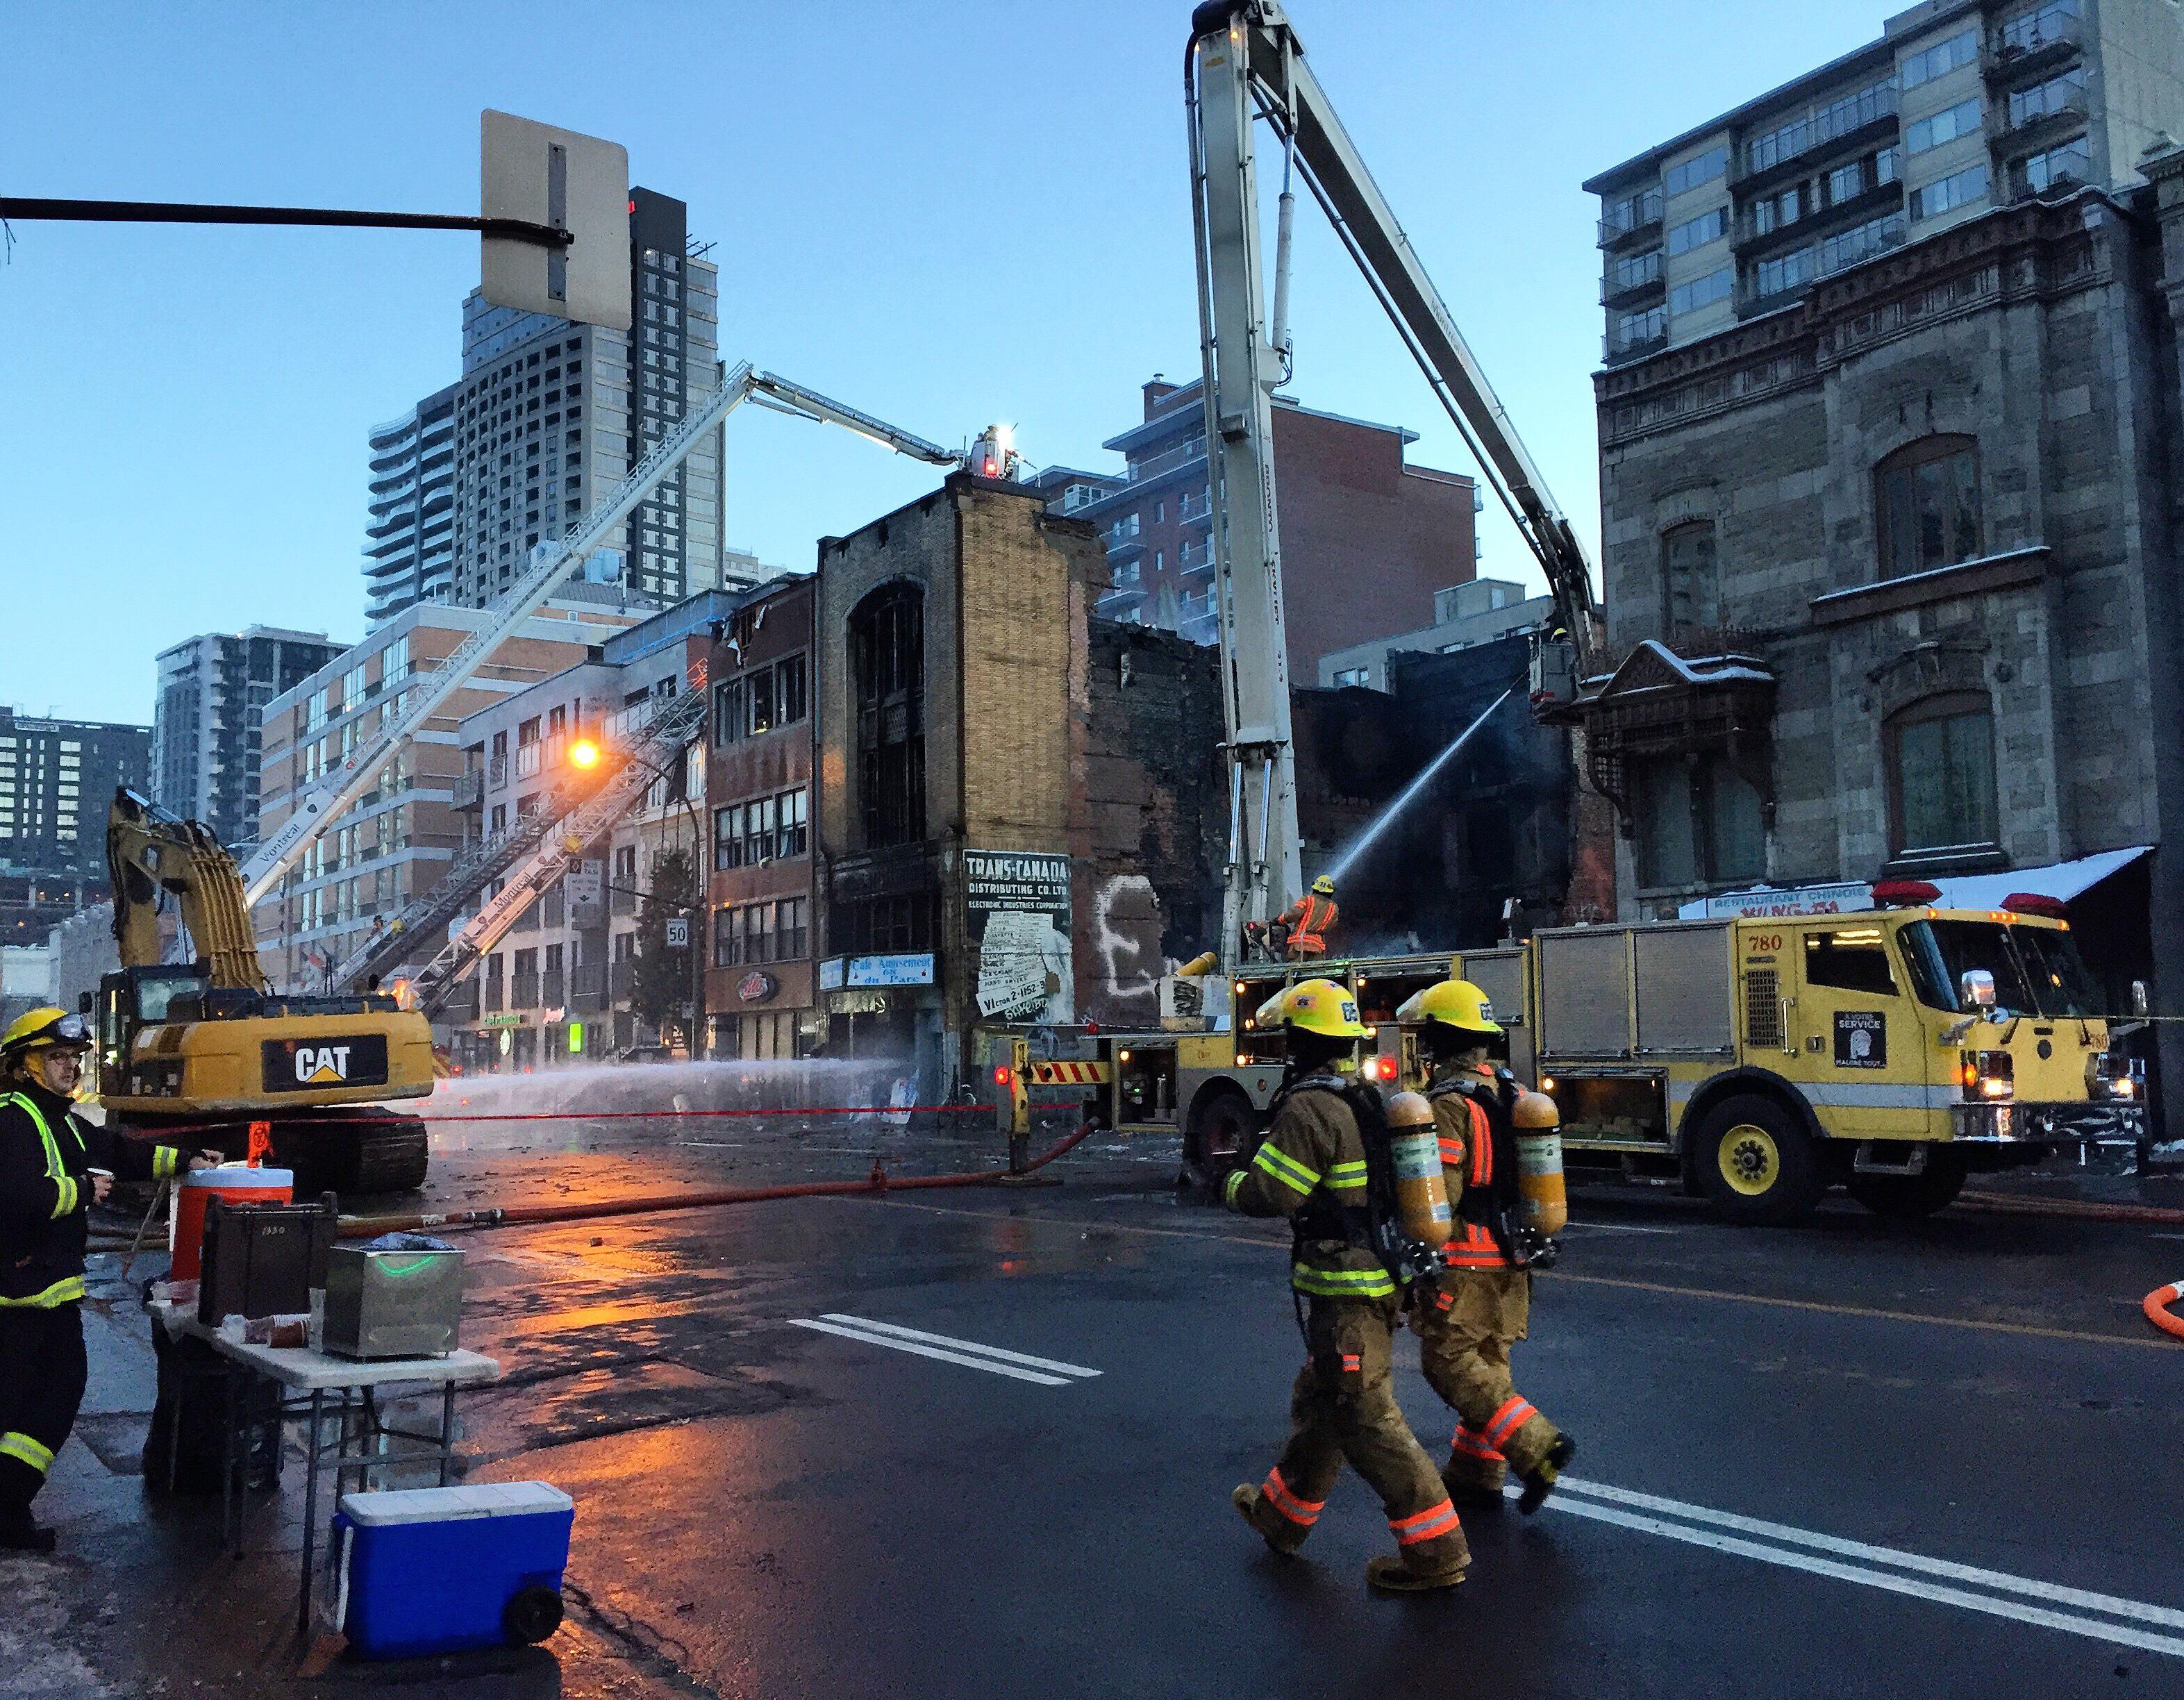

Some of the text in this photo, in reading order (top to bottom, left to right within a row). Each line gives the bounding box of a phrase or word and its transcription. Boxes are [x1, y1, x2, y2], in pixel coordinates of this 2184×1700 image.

[967, 858, 1067, 882] TRANS-CANADA
[969, 883, 1033, 895] DISTRIBUTING
[1715, 887, 1867, 908] RESTAURANT CHINOIS
[1003, 901, 1035, 910] INDUSTRIES
[669, 927, 685, 941] 50
[1749, 934, 1783, 951] 780
[1838, 1019, 1881, 1028] SERVICE
[295, 1047, 351, 1083] CAT
